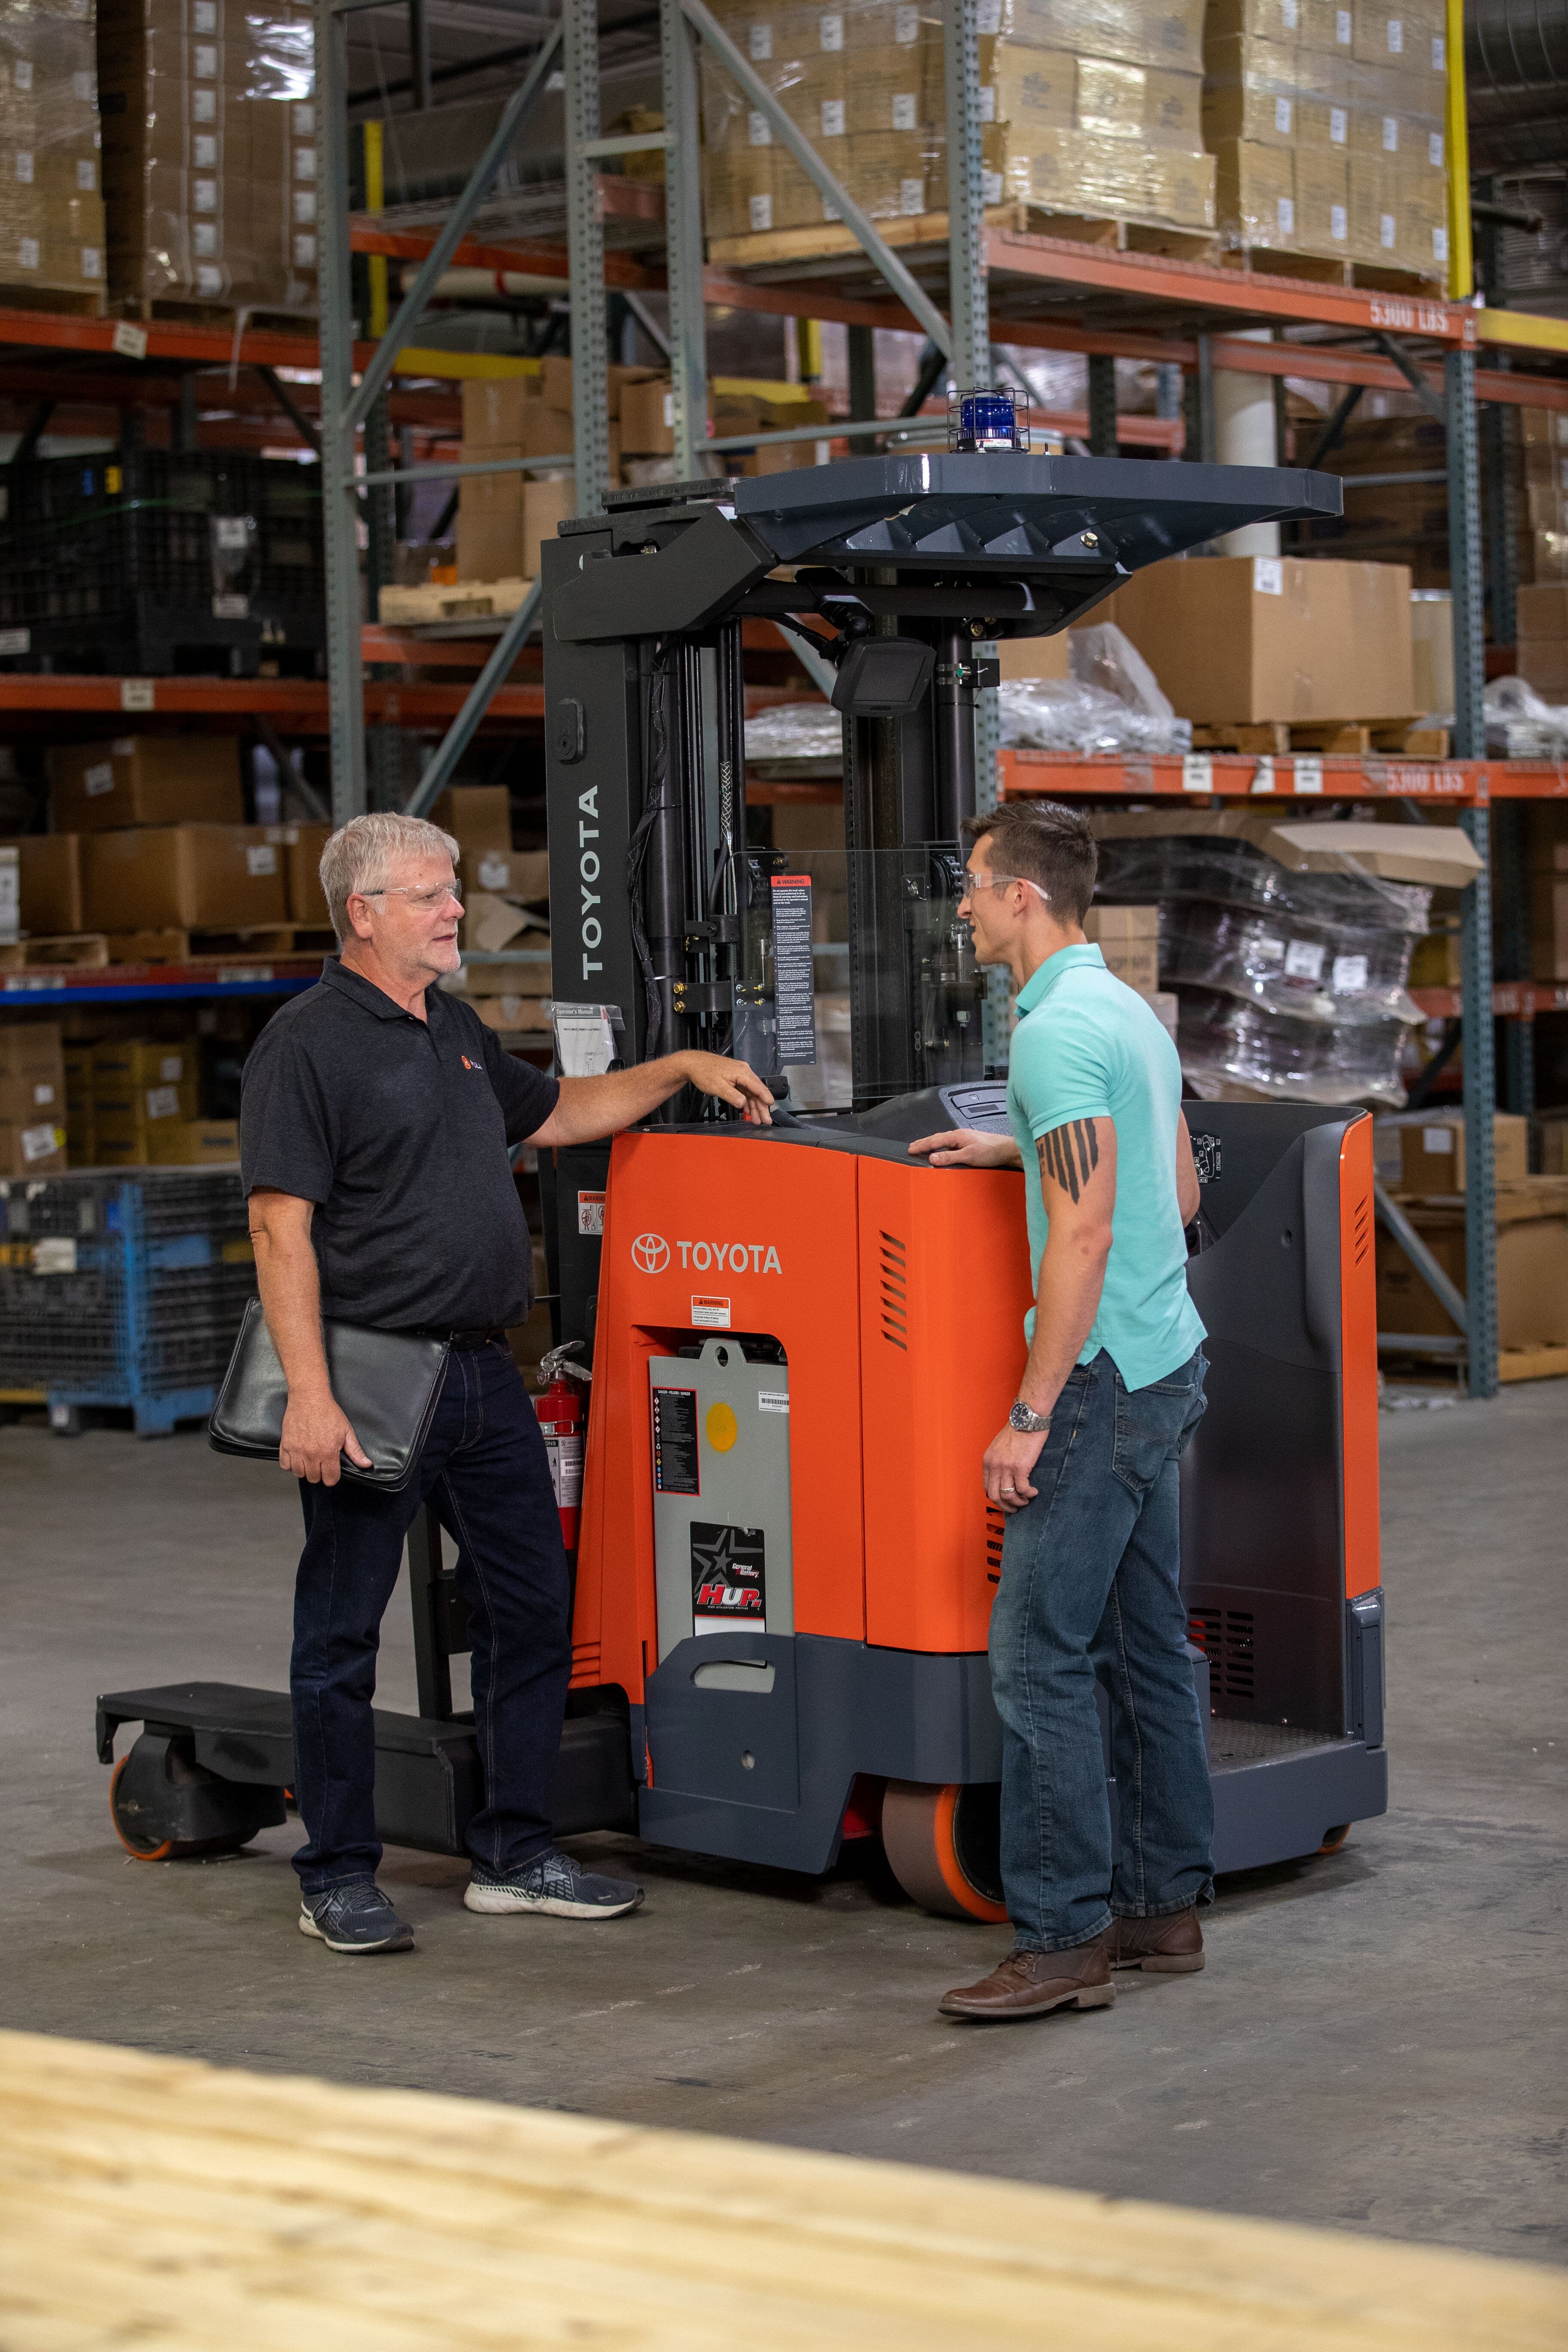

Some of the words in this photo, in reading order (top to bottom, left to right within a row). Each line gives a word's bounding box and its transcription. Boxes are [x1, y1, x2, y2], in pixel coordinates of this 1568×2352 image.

[579, 785, 603, 980] TOYOTA
[677, 1241, 782, 1274] TOYOTA
[740, 1569, 759, 1578] Battery
